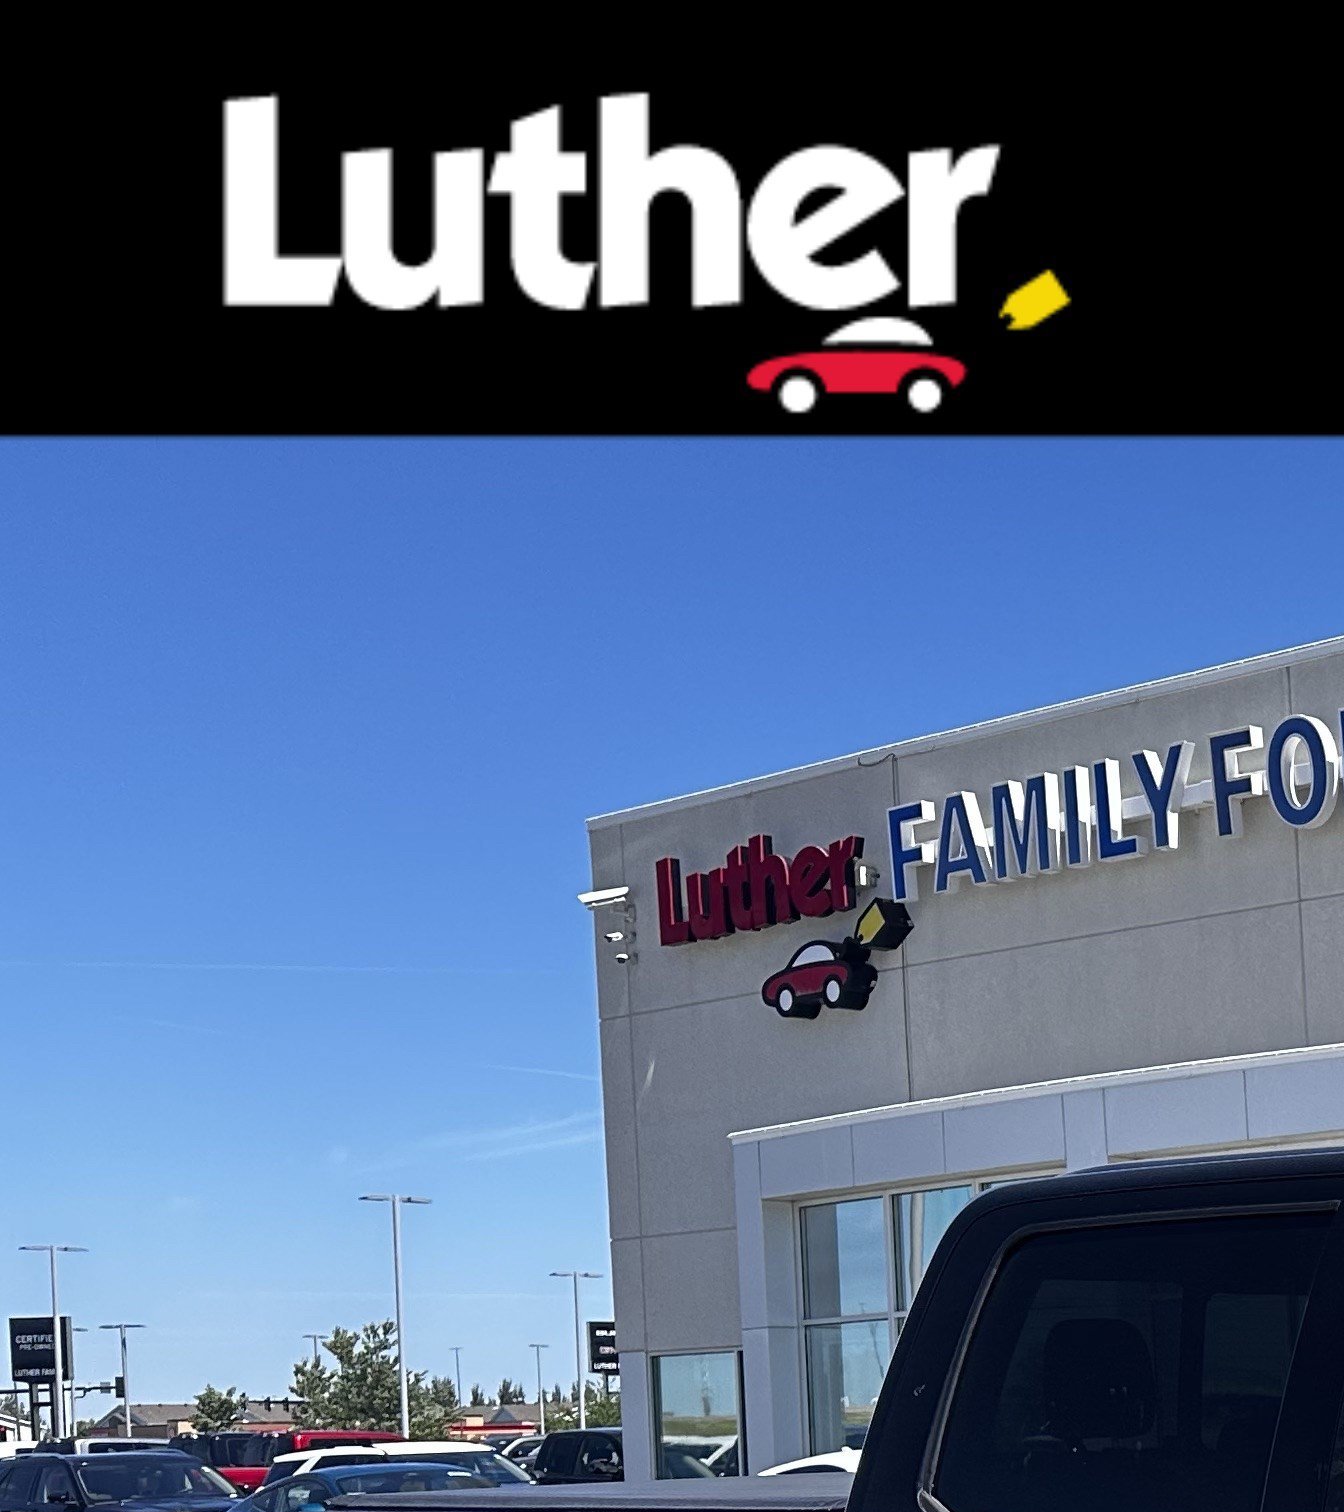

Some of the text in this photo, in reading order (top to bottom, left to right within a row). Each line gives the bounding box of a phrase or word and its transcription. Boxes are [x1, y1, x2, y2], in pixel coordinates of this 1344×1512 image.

[886, 740, 1194, 902] FAMILY
[656, 834, 865, 946] Luther
[15, 1334, 54, 1344] CERTIFIE
